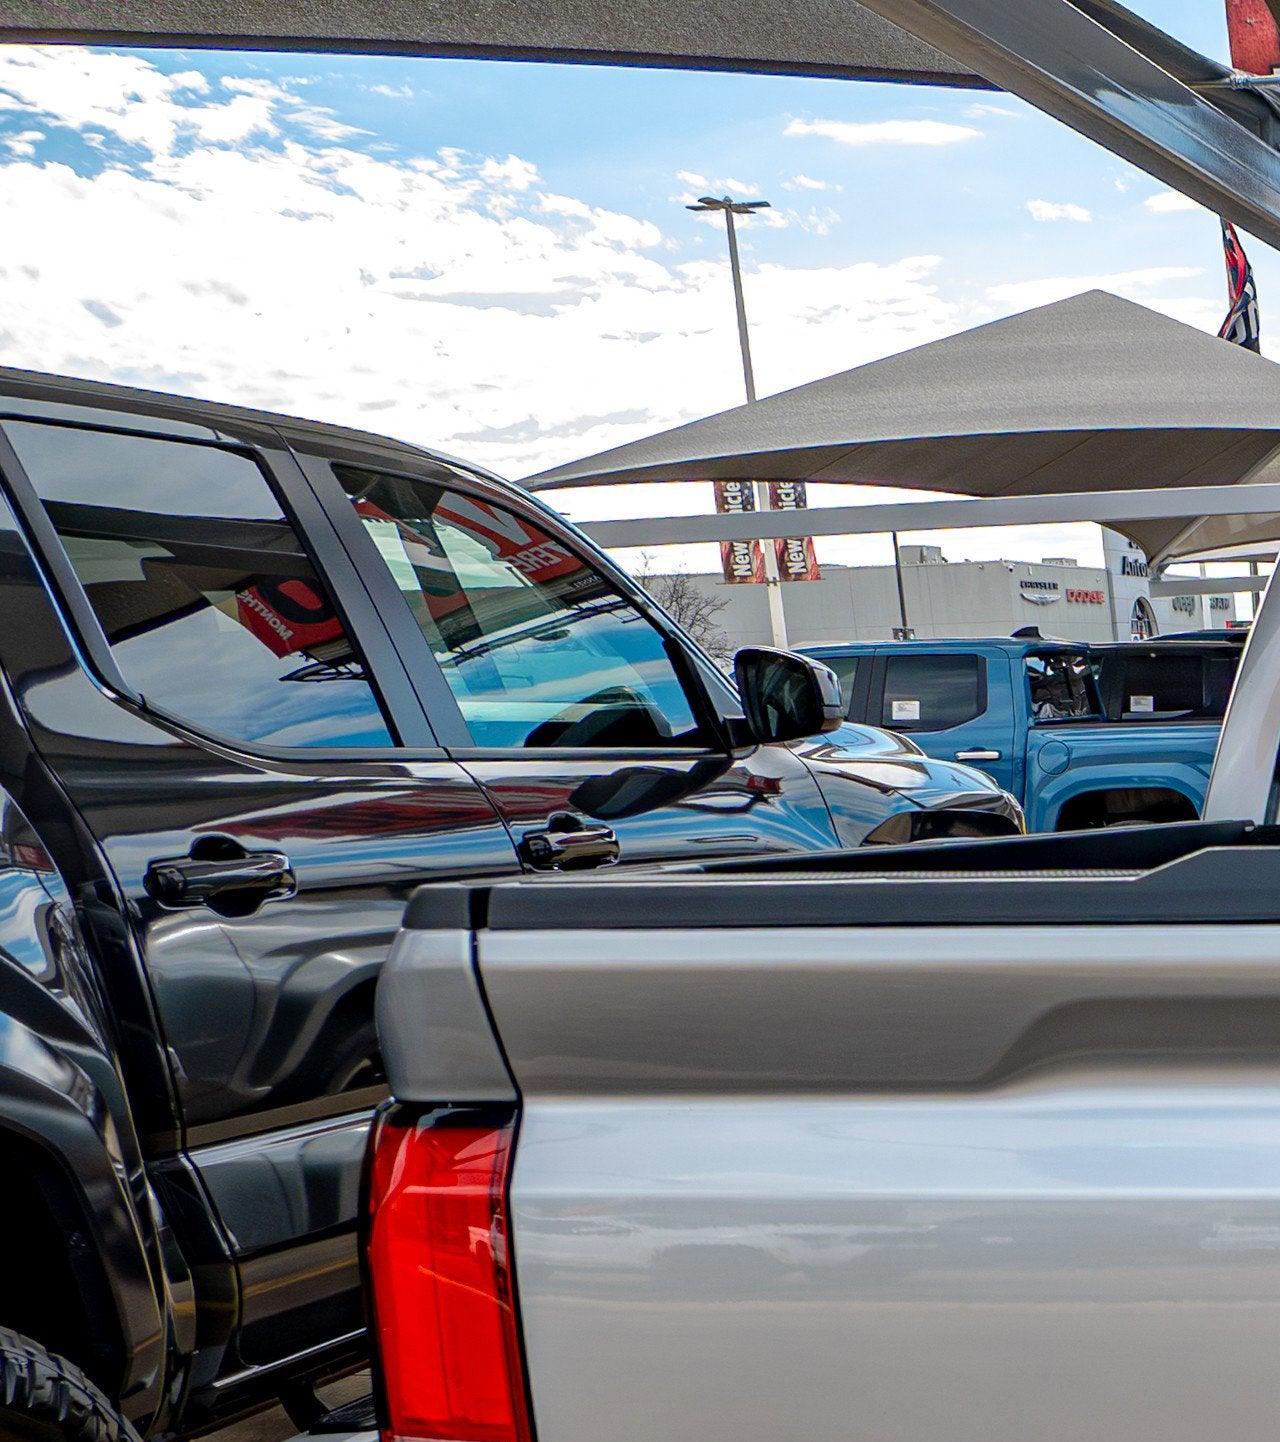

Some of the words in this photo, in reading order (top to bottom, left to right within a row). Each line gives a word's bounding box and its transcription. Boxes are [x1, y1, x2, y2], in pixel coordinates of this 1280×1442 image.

[733, 541, 753, 577] New
[787, 539, 807, 575] New
[1066, 588, 1105, 604] DODGE
